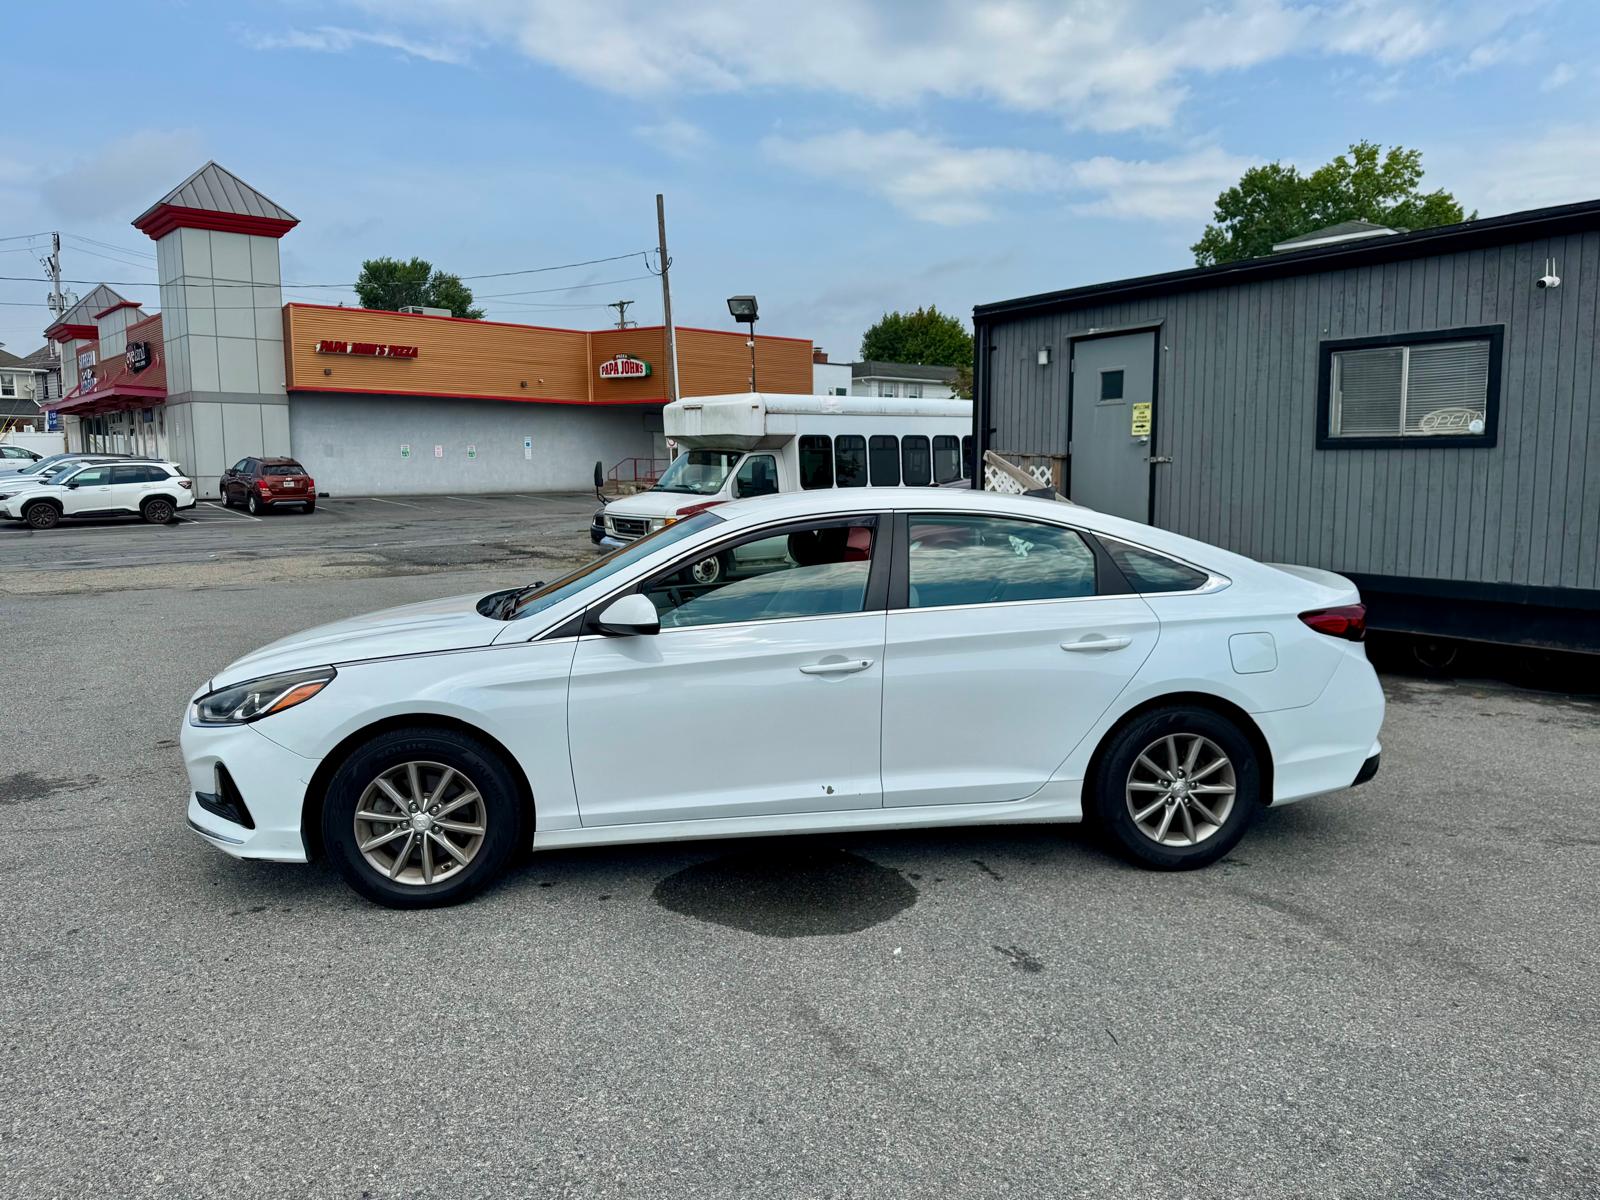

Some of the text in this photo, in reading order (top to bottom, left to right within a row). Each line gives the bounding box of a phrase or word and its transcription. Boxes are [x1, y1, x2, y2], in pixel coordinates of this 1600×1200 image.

[318, 339, 349, 354] PAPA
[601, 360, 643, 375] PAPA JOHNS
[1421, 413, 1478, 428] OPEN
